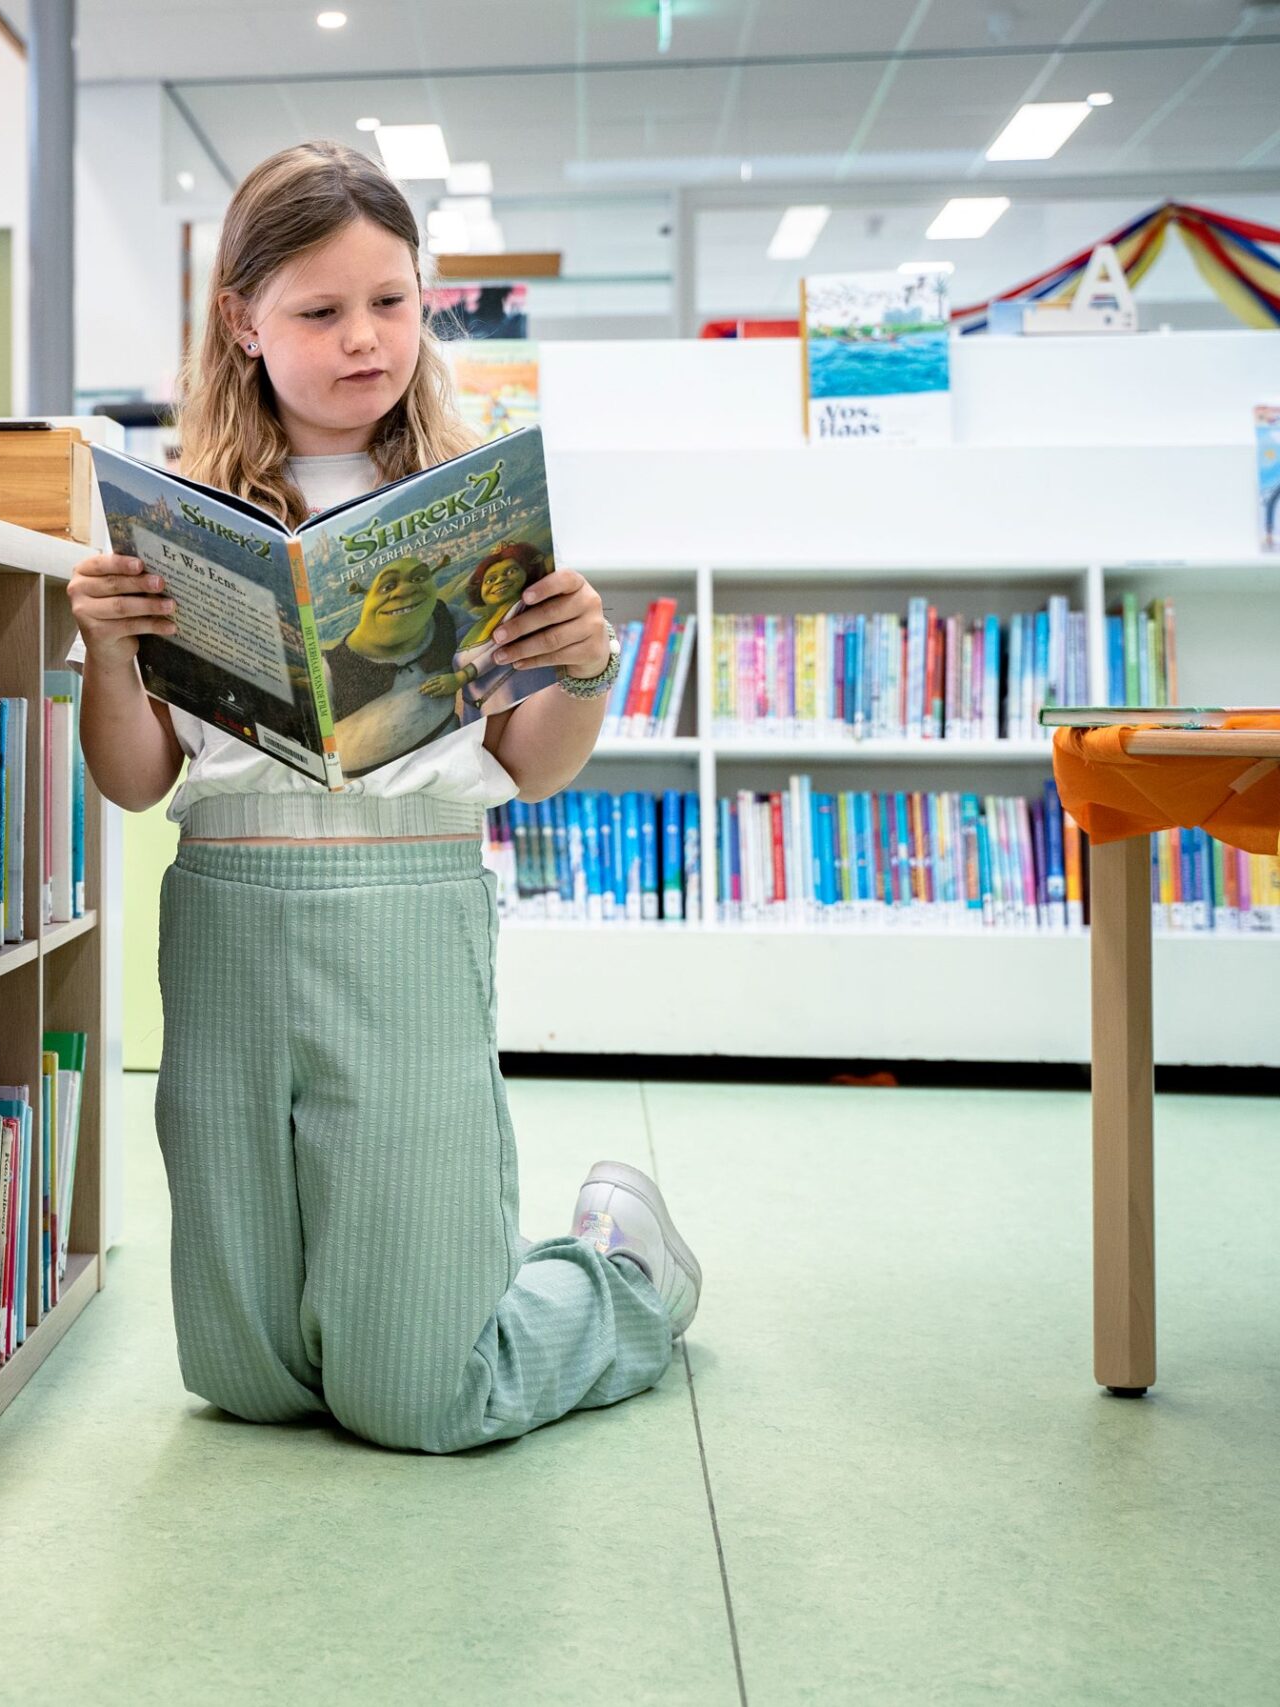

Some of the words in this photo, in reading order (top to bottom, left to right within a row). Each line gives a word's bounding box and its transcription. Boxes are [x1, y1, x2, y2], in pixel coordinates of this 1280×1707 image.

[466, 459, 505, 509] 2
[161, 544, 176, 561] Er
[180, 552, 205, 576] Was
[250, 532, 273, 562] 2
[338, 565, 367, 584] HET
[370, 535, 430, 569] VERHAAL
[432, 521, 461, 539] VAN
[461, 511, 480, 528] DE
[480, 496, 513, 517] FILM
